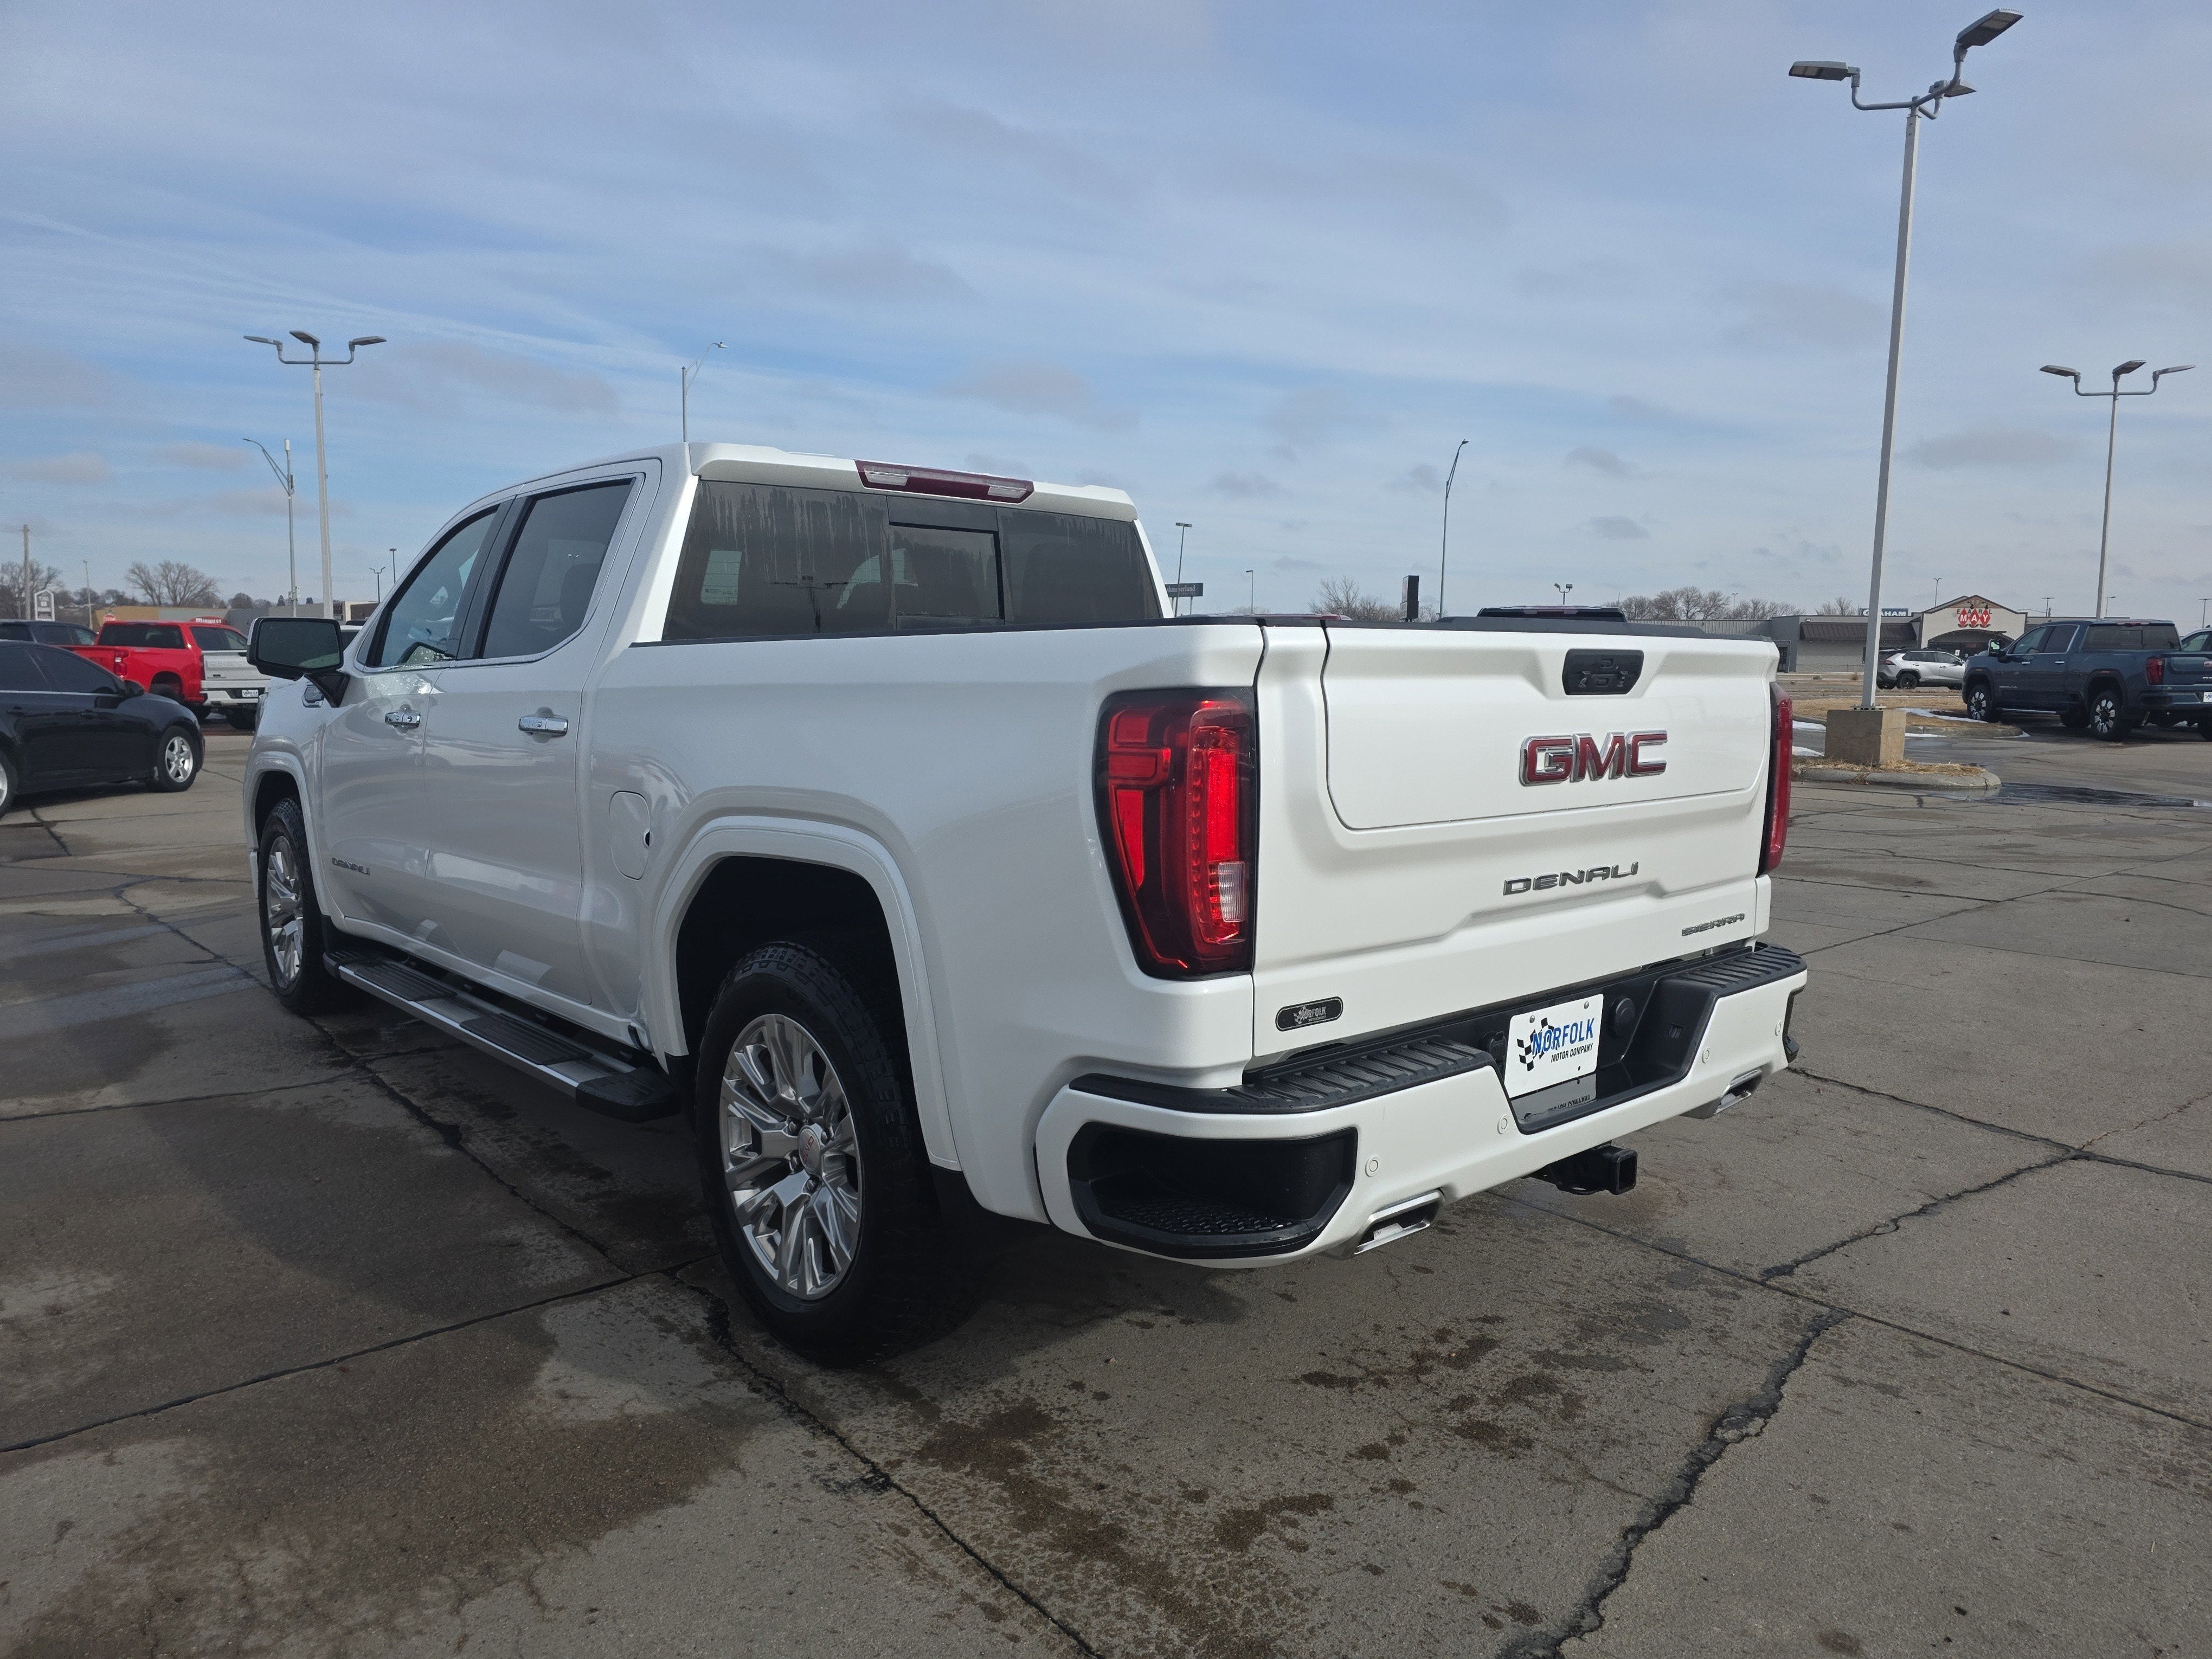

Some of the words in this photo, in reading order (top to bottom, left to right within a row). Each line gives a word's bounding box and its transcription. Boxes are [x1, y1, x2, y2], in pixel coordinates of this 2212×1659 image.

[1519, 730, 1668, 786] GMC
[332, 858, 370, 876] DENALI
[1503, 861, 1638, 895] DENALI
[1682, 913, 1745, 936] SIERRA
[1532, 1018, 1594, 1055] NORFOLK
[1551, 1051, 1569, 1063] MOTOR
[1570, 1043, 1593, 1057] COMPANY
